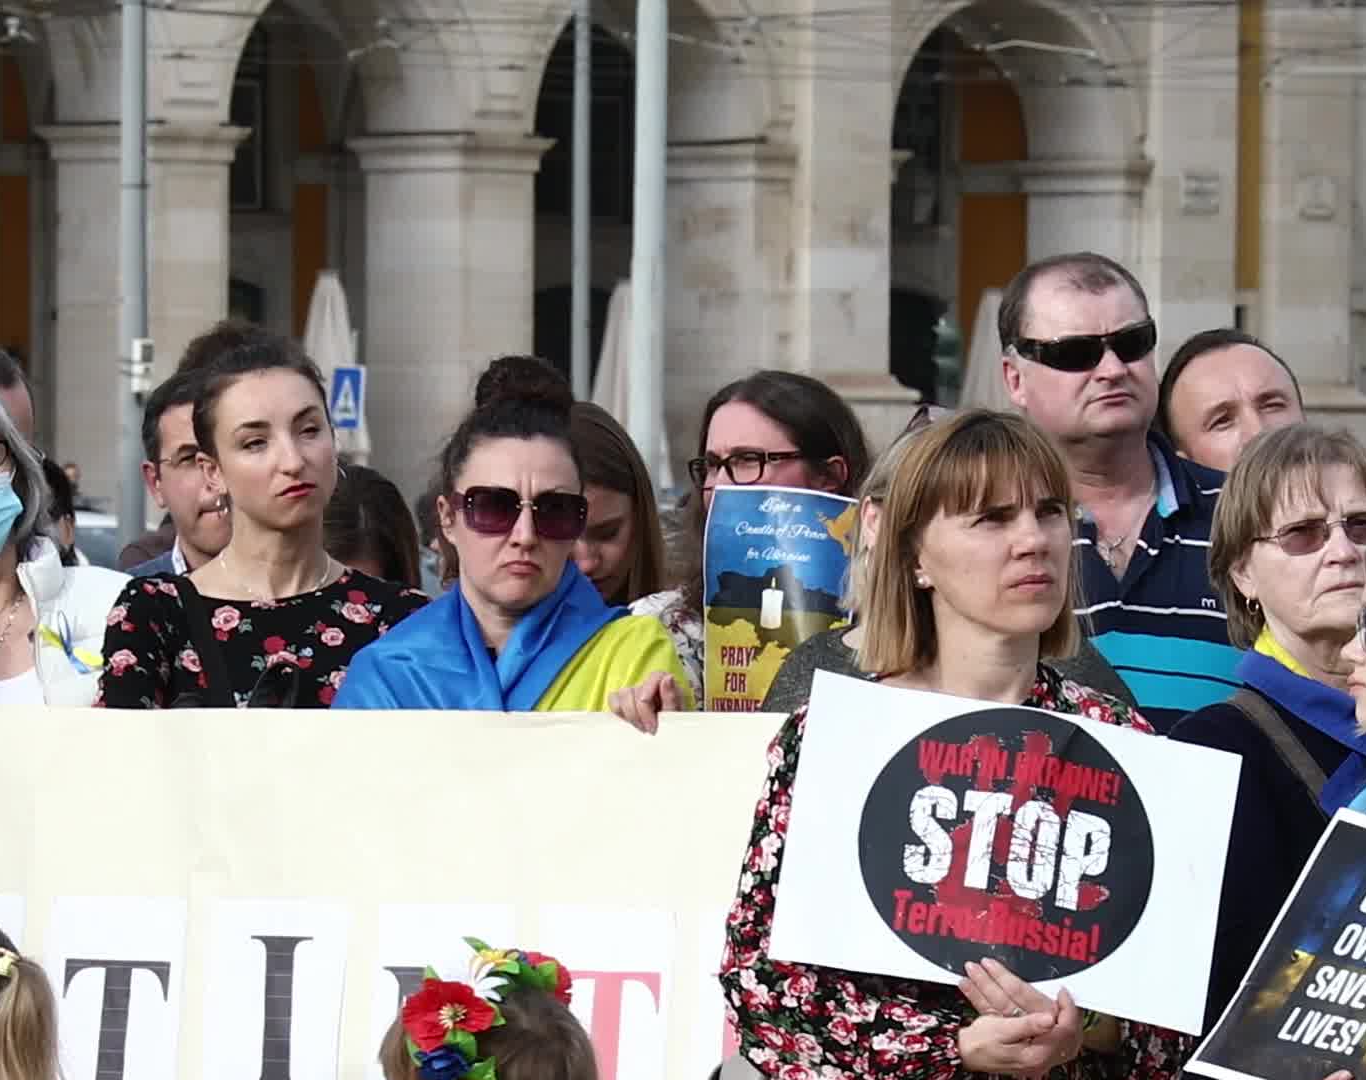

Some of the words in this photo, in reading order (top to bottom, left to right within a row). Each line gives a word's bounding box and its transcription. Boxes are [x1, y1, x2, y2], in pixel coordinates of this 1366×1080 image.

[761, 547, 811, 562] Ukraine
[721, 646, 755, 667] PRAY
[724, 671, 746, 693] FOR
[918, 738, 973, 777] WAR
[1013, 750, 1123, 807] UKRAINE!
[903, 785, 1112, 911] STOP
